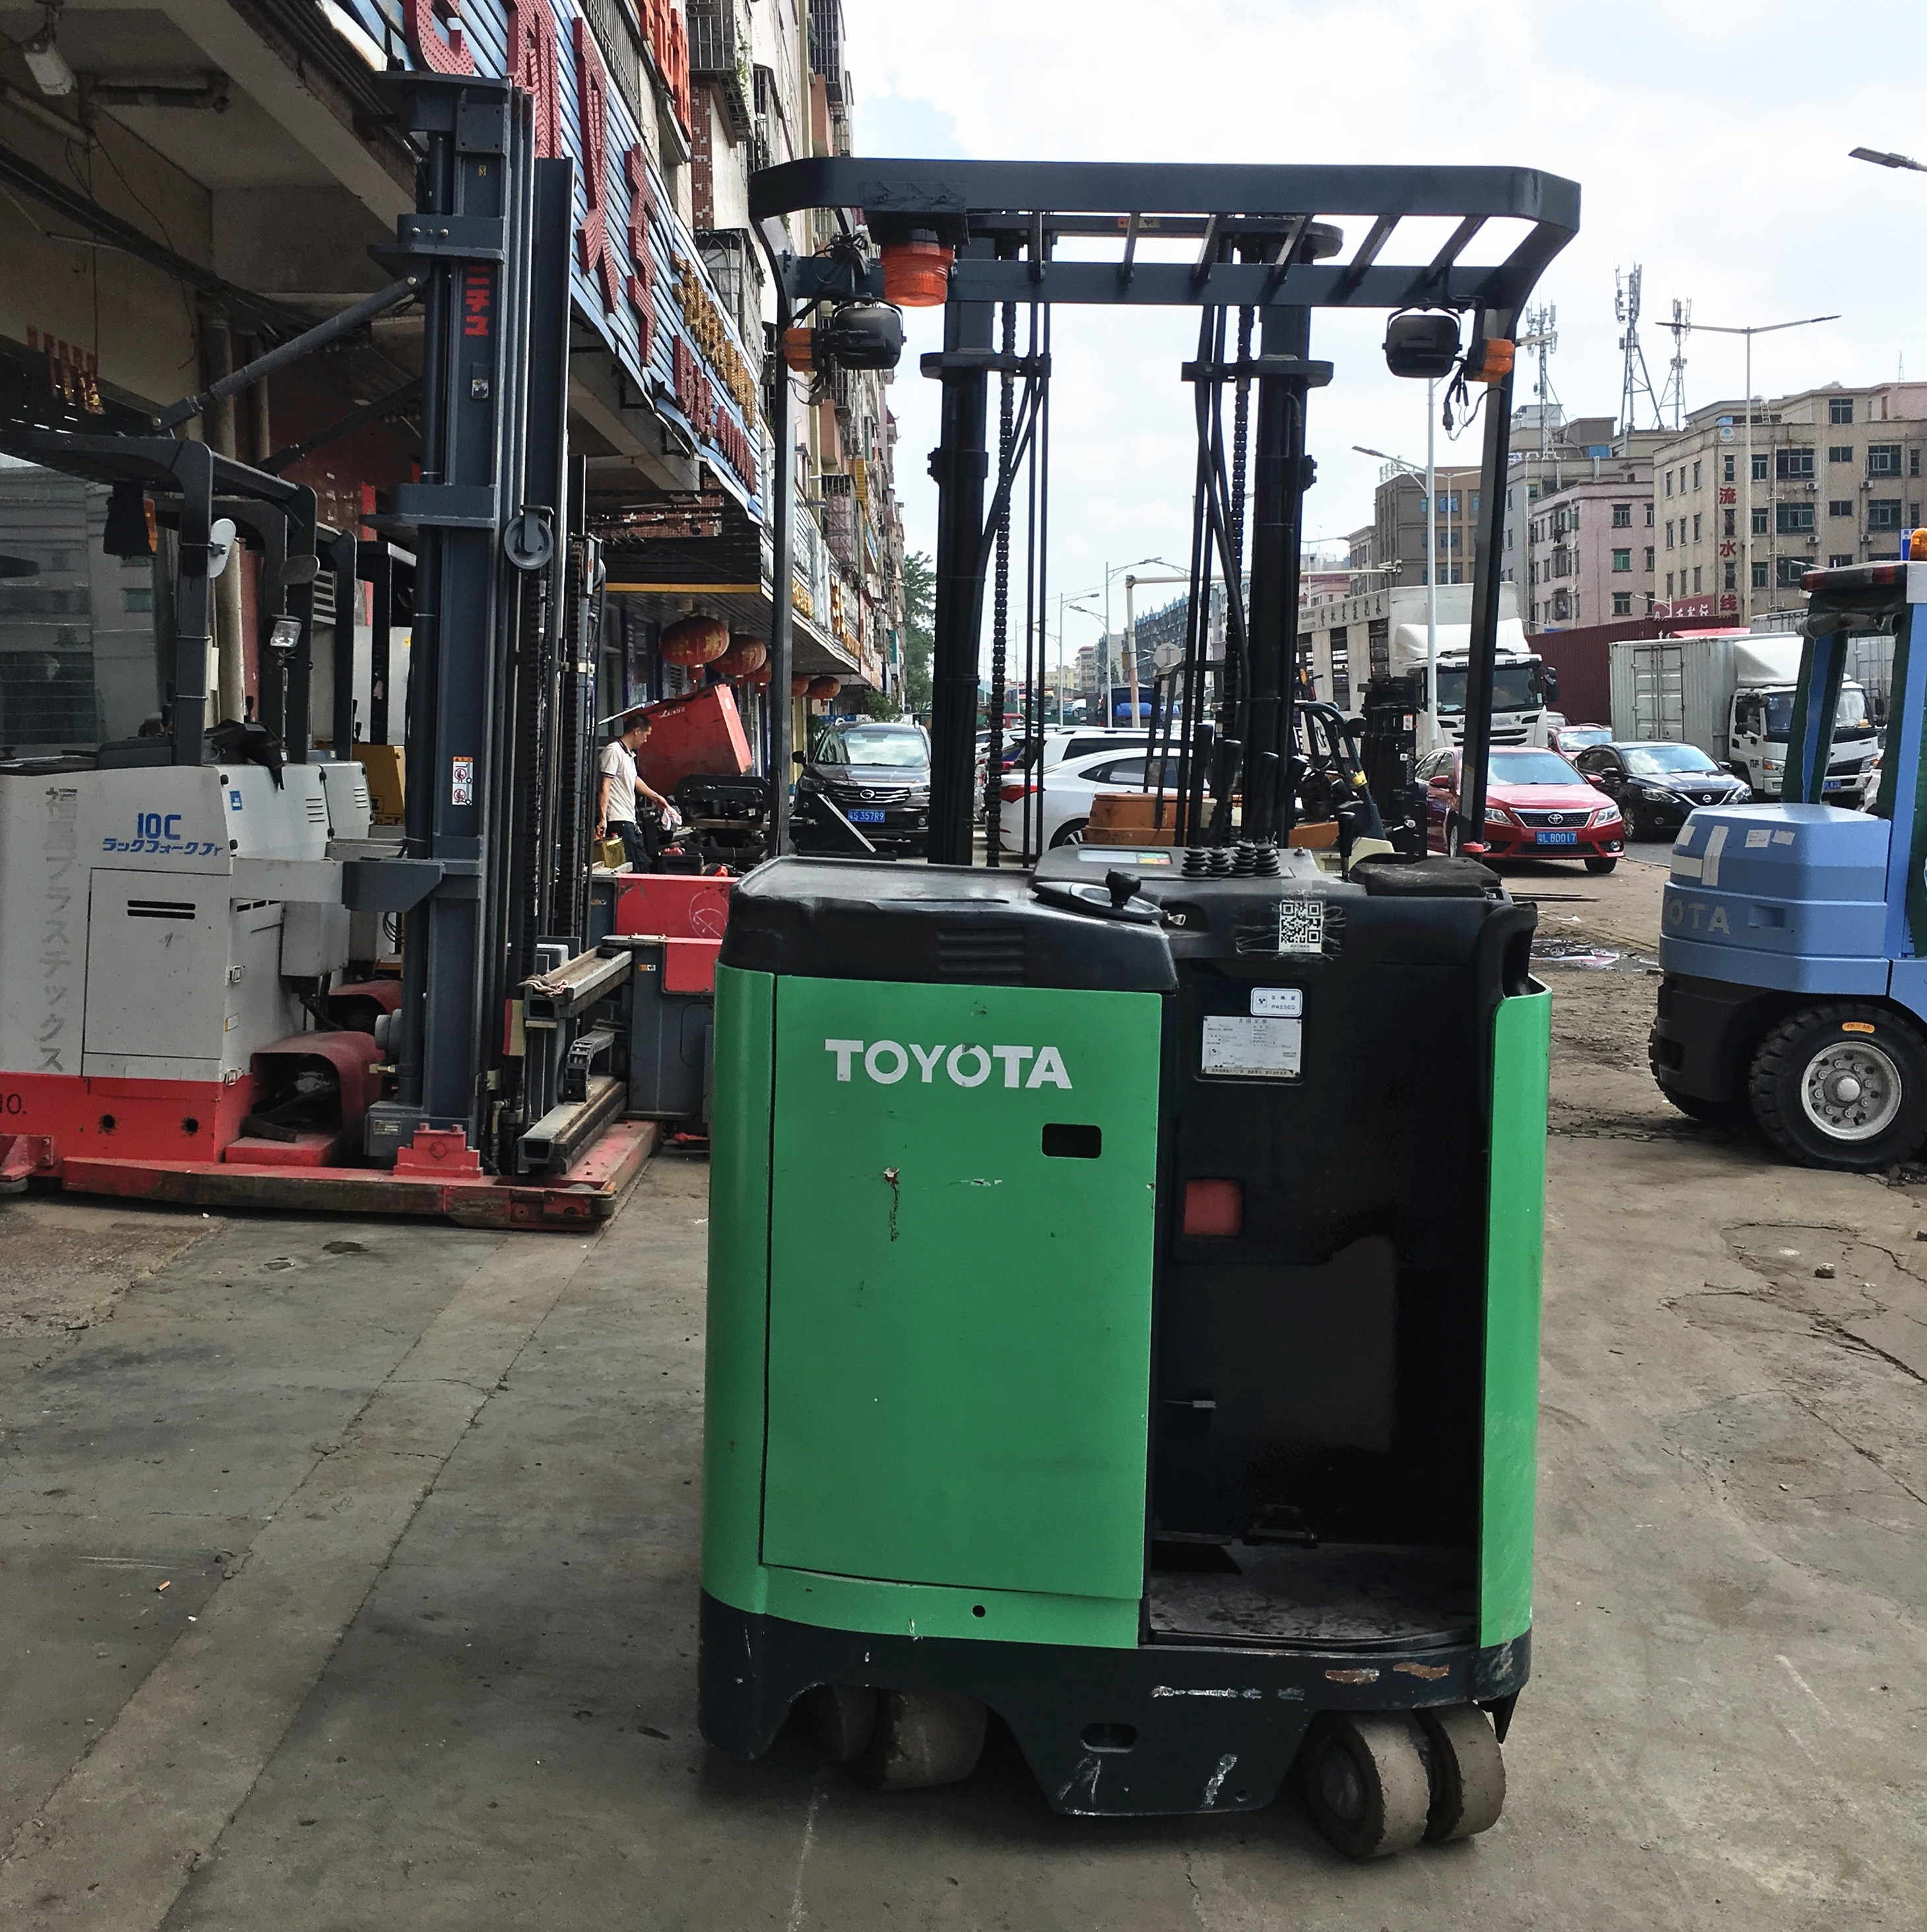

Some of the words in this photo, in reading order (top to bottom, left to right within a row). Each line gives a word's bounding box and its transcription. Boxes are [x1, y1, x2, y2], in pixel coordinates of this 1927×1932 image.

[1719, 487, 1737, 612] 流水线
[825, 1039, 1072, 1089] TOYOTA
